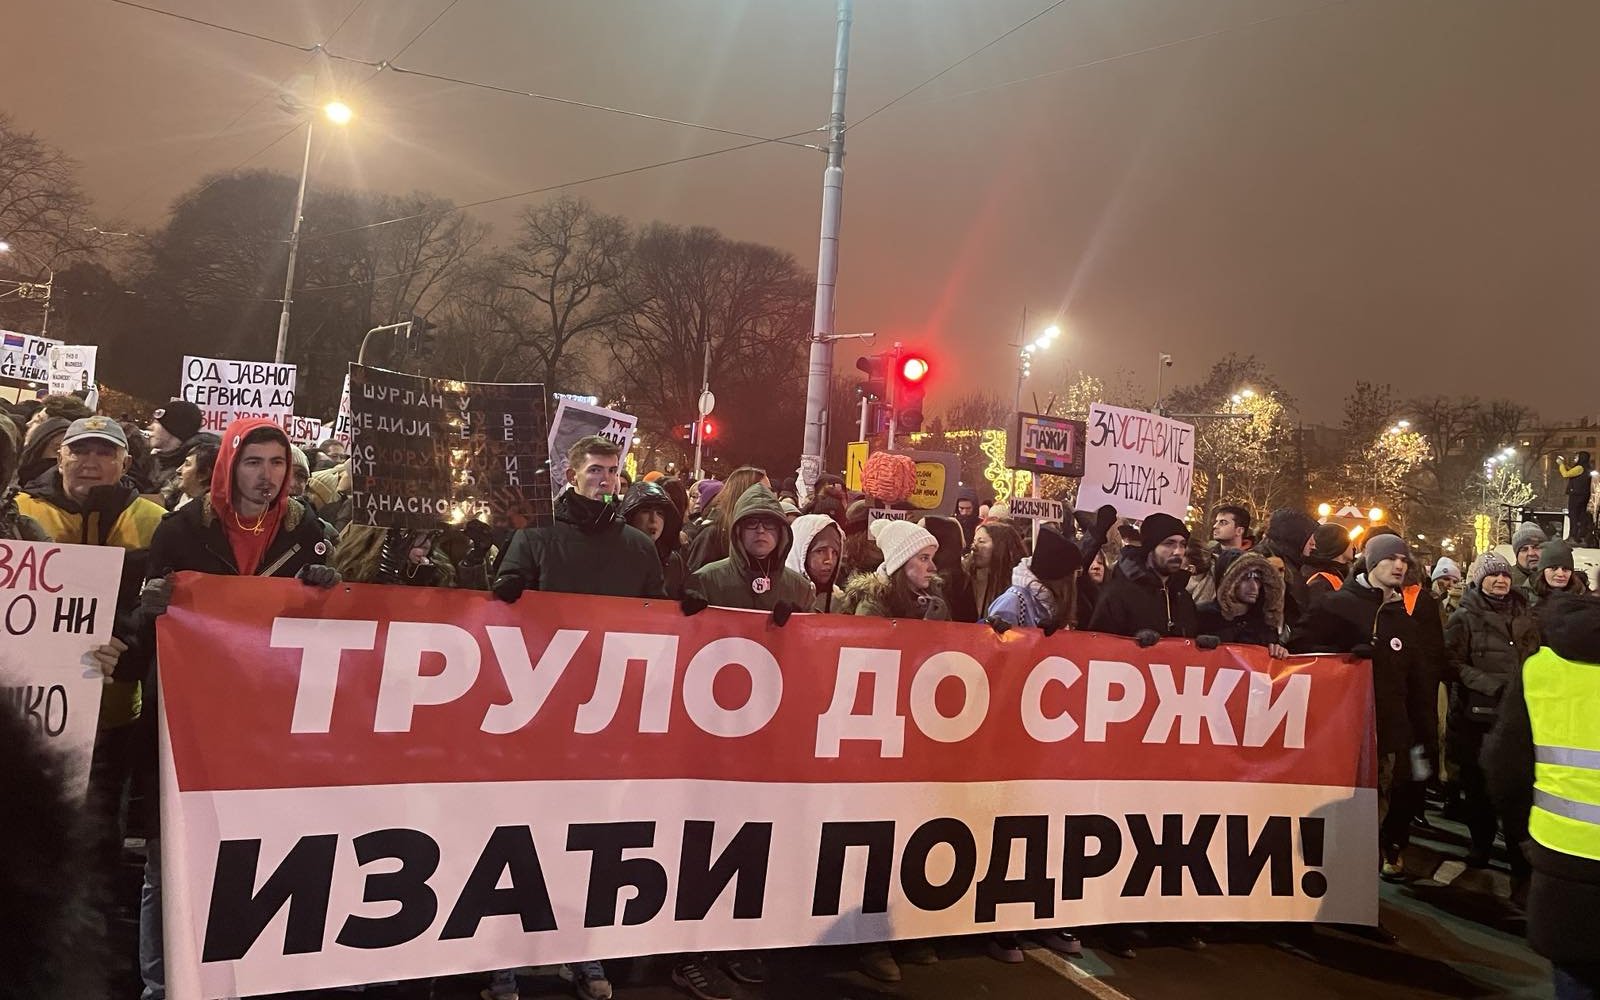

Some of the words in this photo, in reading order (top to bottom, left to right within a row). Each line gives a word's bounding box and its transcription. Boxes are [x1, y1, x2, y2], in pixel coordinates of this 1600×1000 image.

[28, 340, 56, 356] ГОР
[1, 364, 16, 377] СЕ
[188, 359, 221, 383] ОД
[228, 362, 297, 386] ЈАВНОГ
[183, 384, 263, 408] СЕРВИСА
[269, 390, 295, 407] ДО
[363, 384, 443, 409] ШУРЛАН
[200, 411, 228, 431] ВНЕ
[351, 409, 431, 437] МЕДИЈИ
[1101, 463, 1170, 505] ЈАНУАР
[5, 594, 37, 635] О
[53, 597, 97, 634] НИ
[270, 617, 784, 738] ТРУЛО
[815, 646, 990, 758] ДО
[1021, 656, 1312, 749] СРЖИ
[202, 819, 773, 963] ИЗАЂИ
[812, 813, 1328, 923] ПОДРЖИ!
